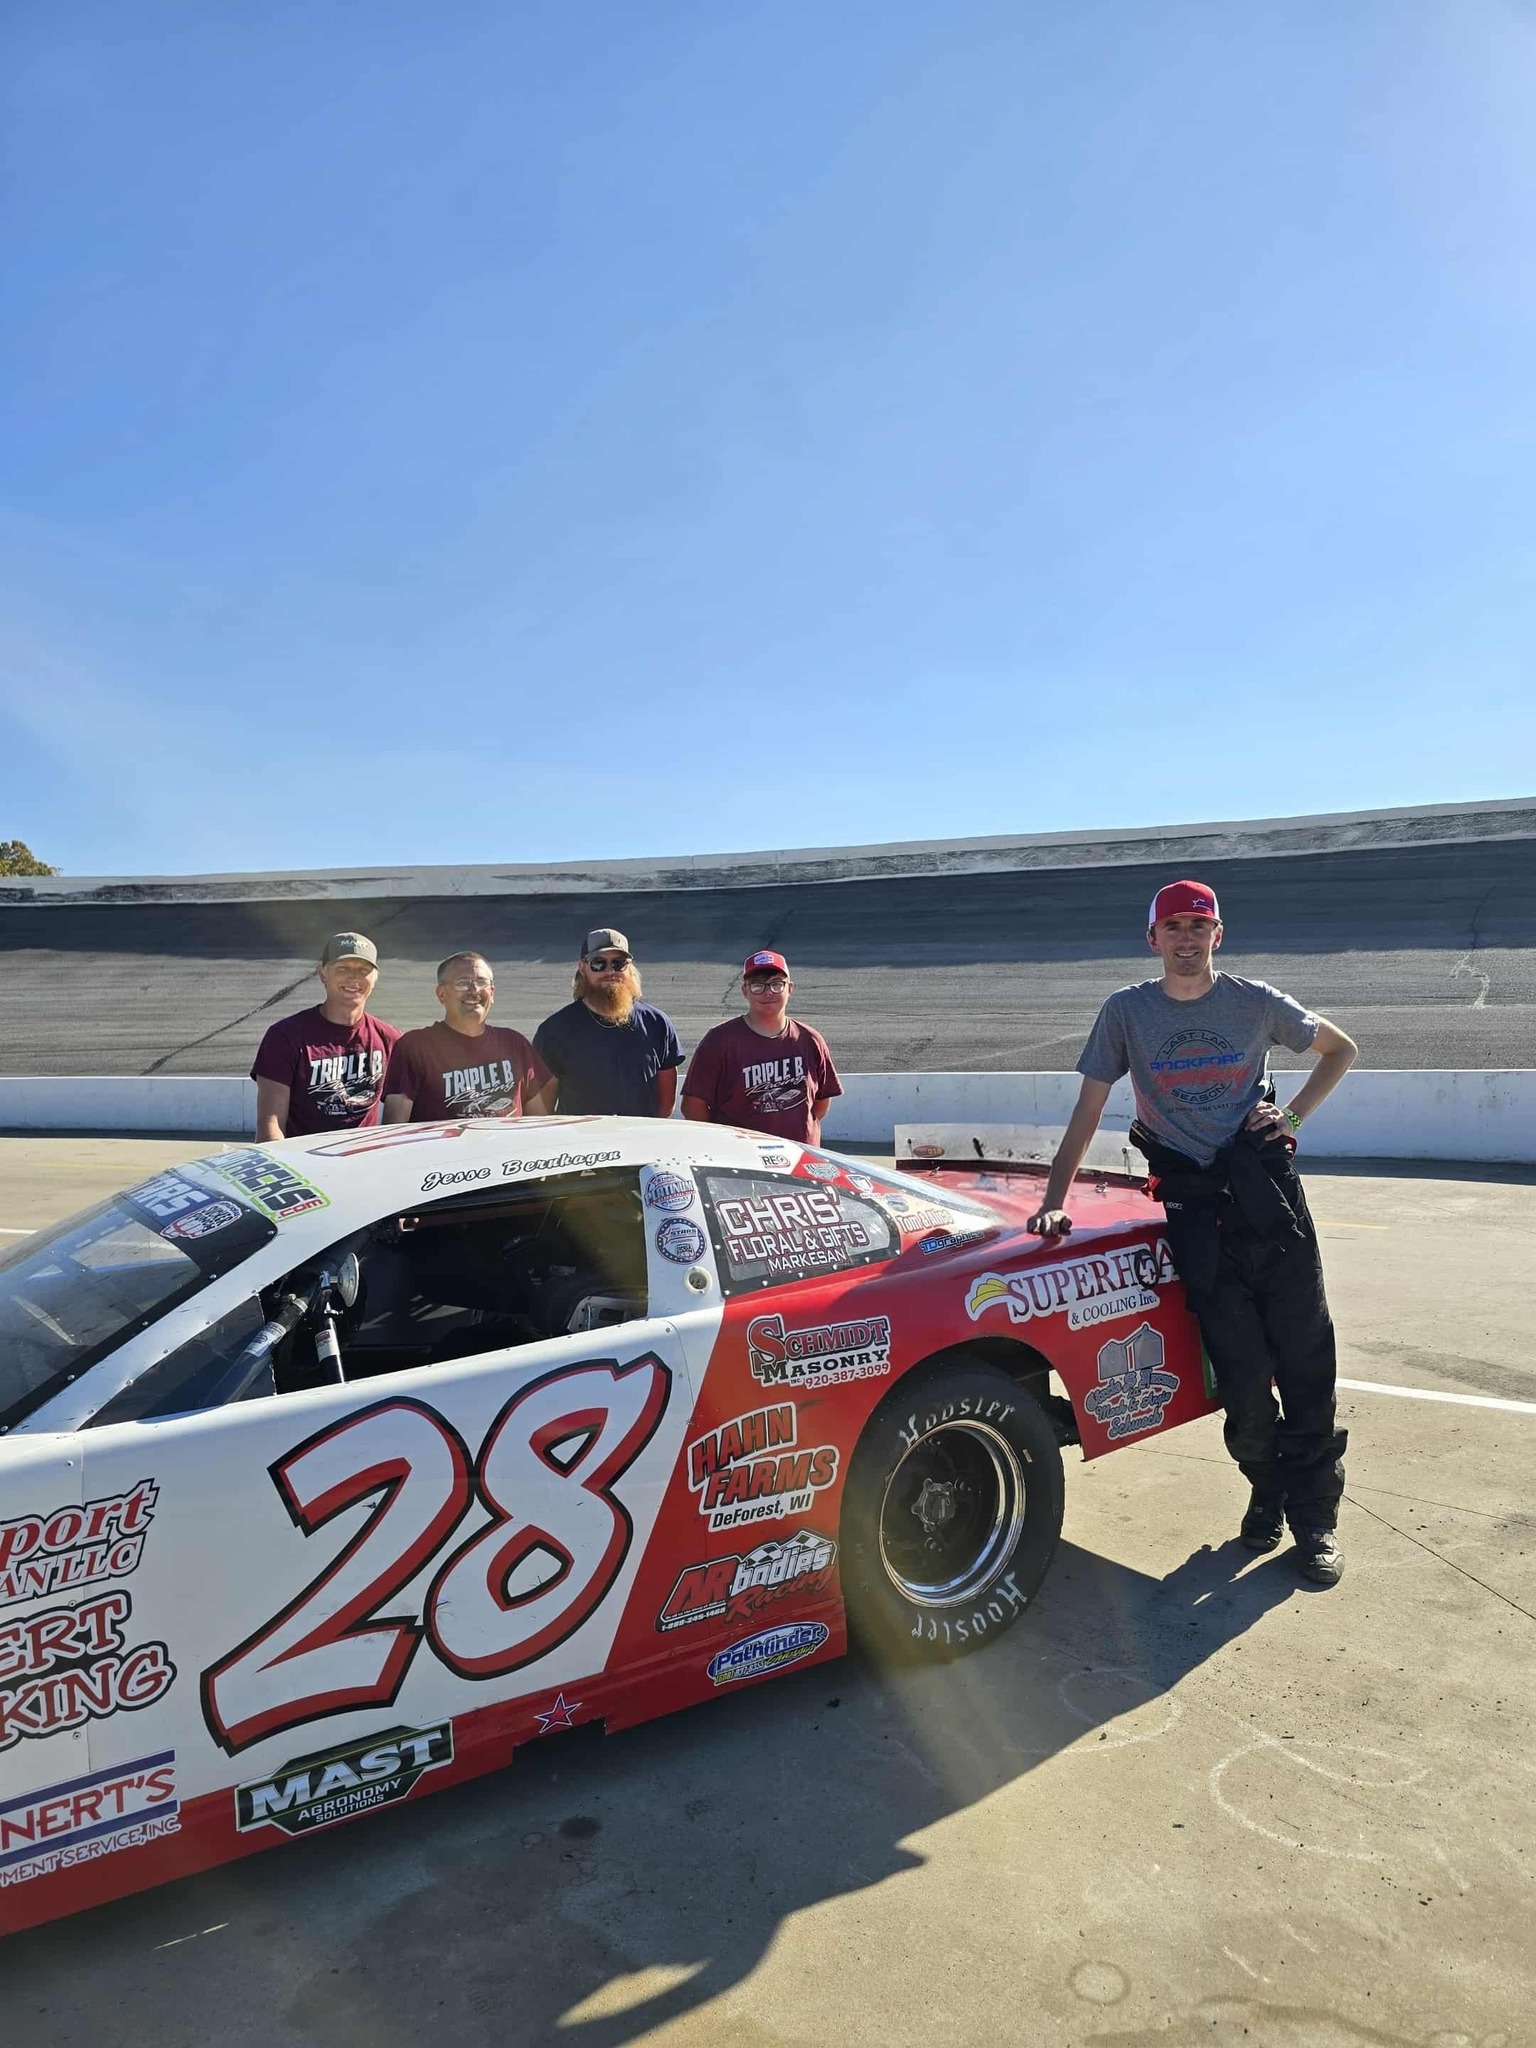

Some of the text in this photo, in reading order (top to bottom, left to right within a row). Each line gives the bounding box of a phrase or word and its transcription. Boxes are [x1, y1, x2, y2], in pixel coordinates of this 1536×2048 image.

[1149, 1052, 1246, 1071] ROCKFORD
[1163, 1032, 1228, 1054] LAST LAP
[310, 1050, 383, 1086] TRIPLE B
[443, 1060, 514, 1098] TRIPLE B
[743, 1056, 804, 1089] TRIPLE B
[444, 1081, 514, 1108] Racing
[1171, 1083, 1225, 1103] SEASON
[421, 1150, 621, 1191] Jesse Bernhagen
[644, 1180, 695, 1207] PLATINUM
[720, 1185, 838, 1235] CHRIS'
[896, 1214, 924, 1233] Tom
[727, 1223, 867, 1262] FLORAL & GIFTS
[769, 1250, 847, 1272] MARKESAN
[1071, 1292, 1157, 1325] & COOLING Inc.
[750, 1317, 889, 1362] SCHMIDT
[763, 1350, 888, 1384] MASONRY
[805, 1363, 889, 1388] 920-387-3099
[692, 1405, 794, 1485] HAHN
[703, 1448, 836, 1510] FARMS
[713, 1493, 812, 1529] DeForest, WI
[57, 1539, 140, 1586] LLC
[200, 1351, 672, 1757] 28
[731, 1544, 834, 1597] bodies
[717, 1626, 823, 1671] Pathfinder
[250, 1731, 443, 1822] MAST
[298, 1778, 402, 1822] AGRONOMY
[315, 1793, 386, 1824] SOLUTIONS
[0, 1854, 58, 1886] MENT
[149, 1818, 180, 1839] INC.
